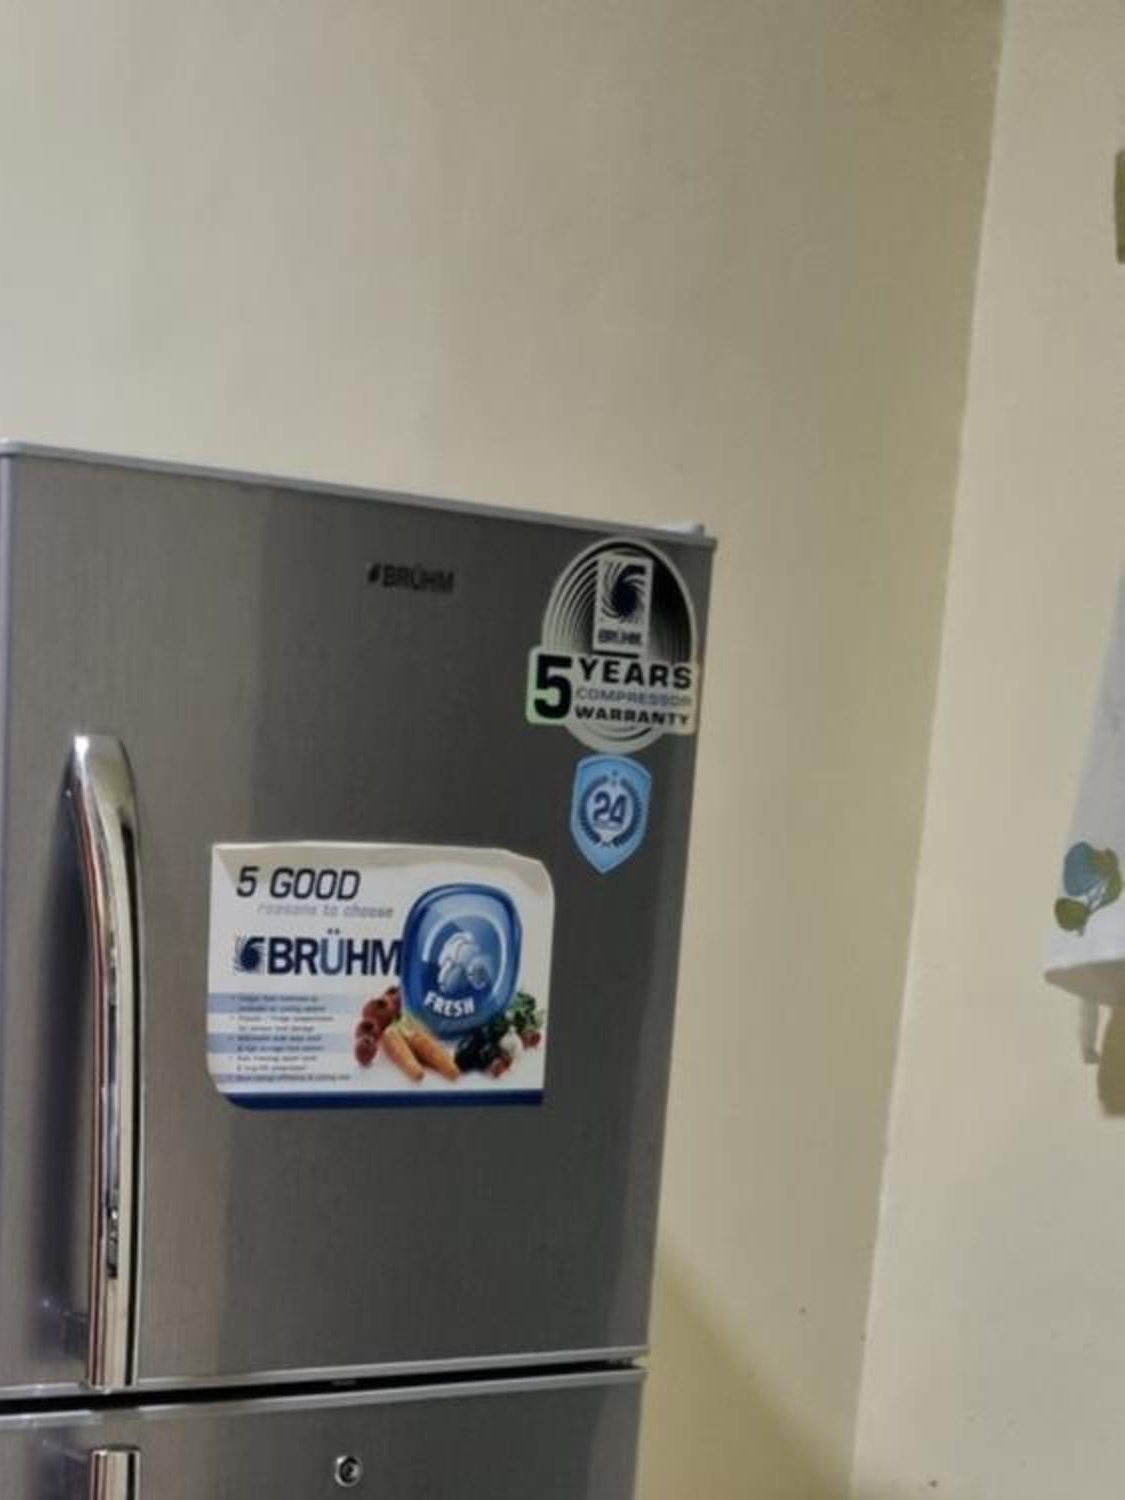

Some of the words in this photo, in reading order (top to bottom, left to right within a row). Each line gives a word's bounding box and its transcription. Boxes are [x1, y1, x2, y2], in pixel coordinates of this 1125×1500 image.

[533, 653, 573, 720] 5
[578, 656, 693, 690] YEARS
[576, 686, 693, 707] COMPRESSOR
[576, 705, 690, 726] WARRANTY
[593, 790, 627, 823] 24
[236, 866, 260, 897] 5
[270, 867, 362, 901] GOOD
[324, 903, 339, 917] to
[343, 904, 394, 919] choose
[267, 927, 404, 977] BRÜHM
[425, 992, 475, 1017] FRESH
